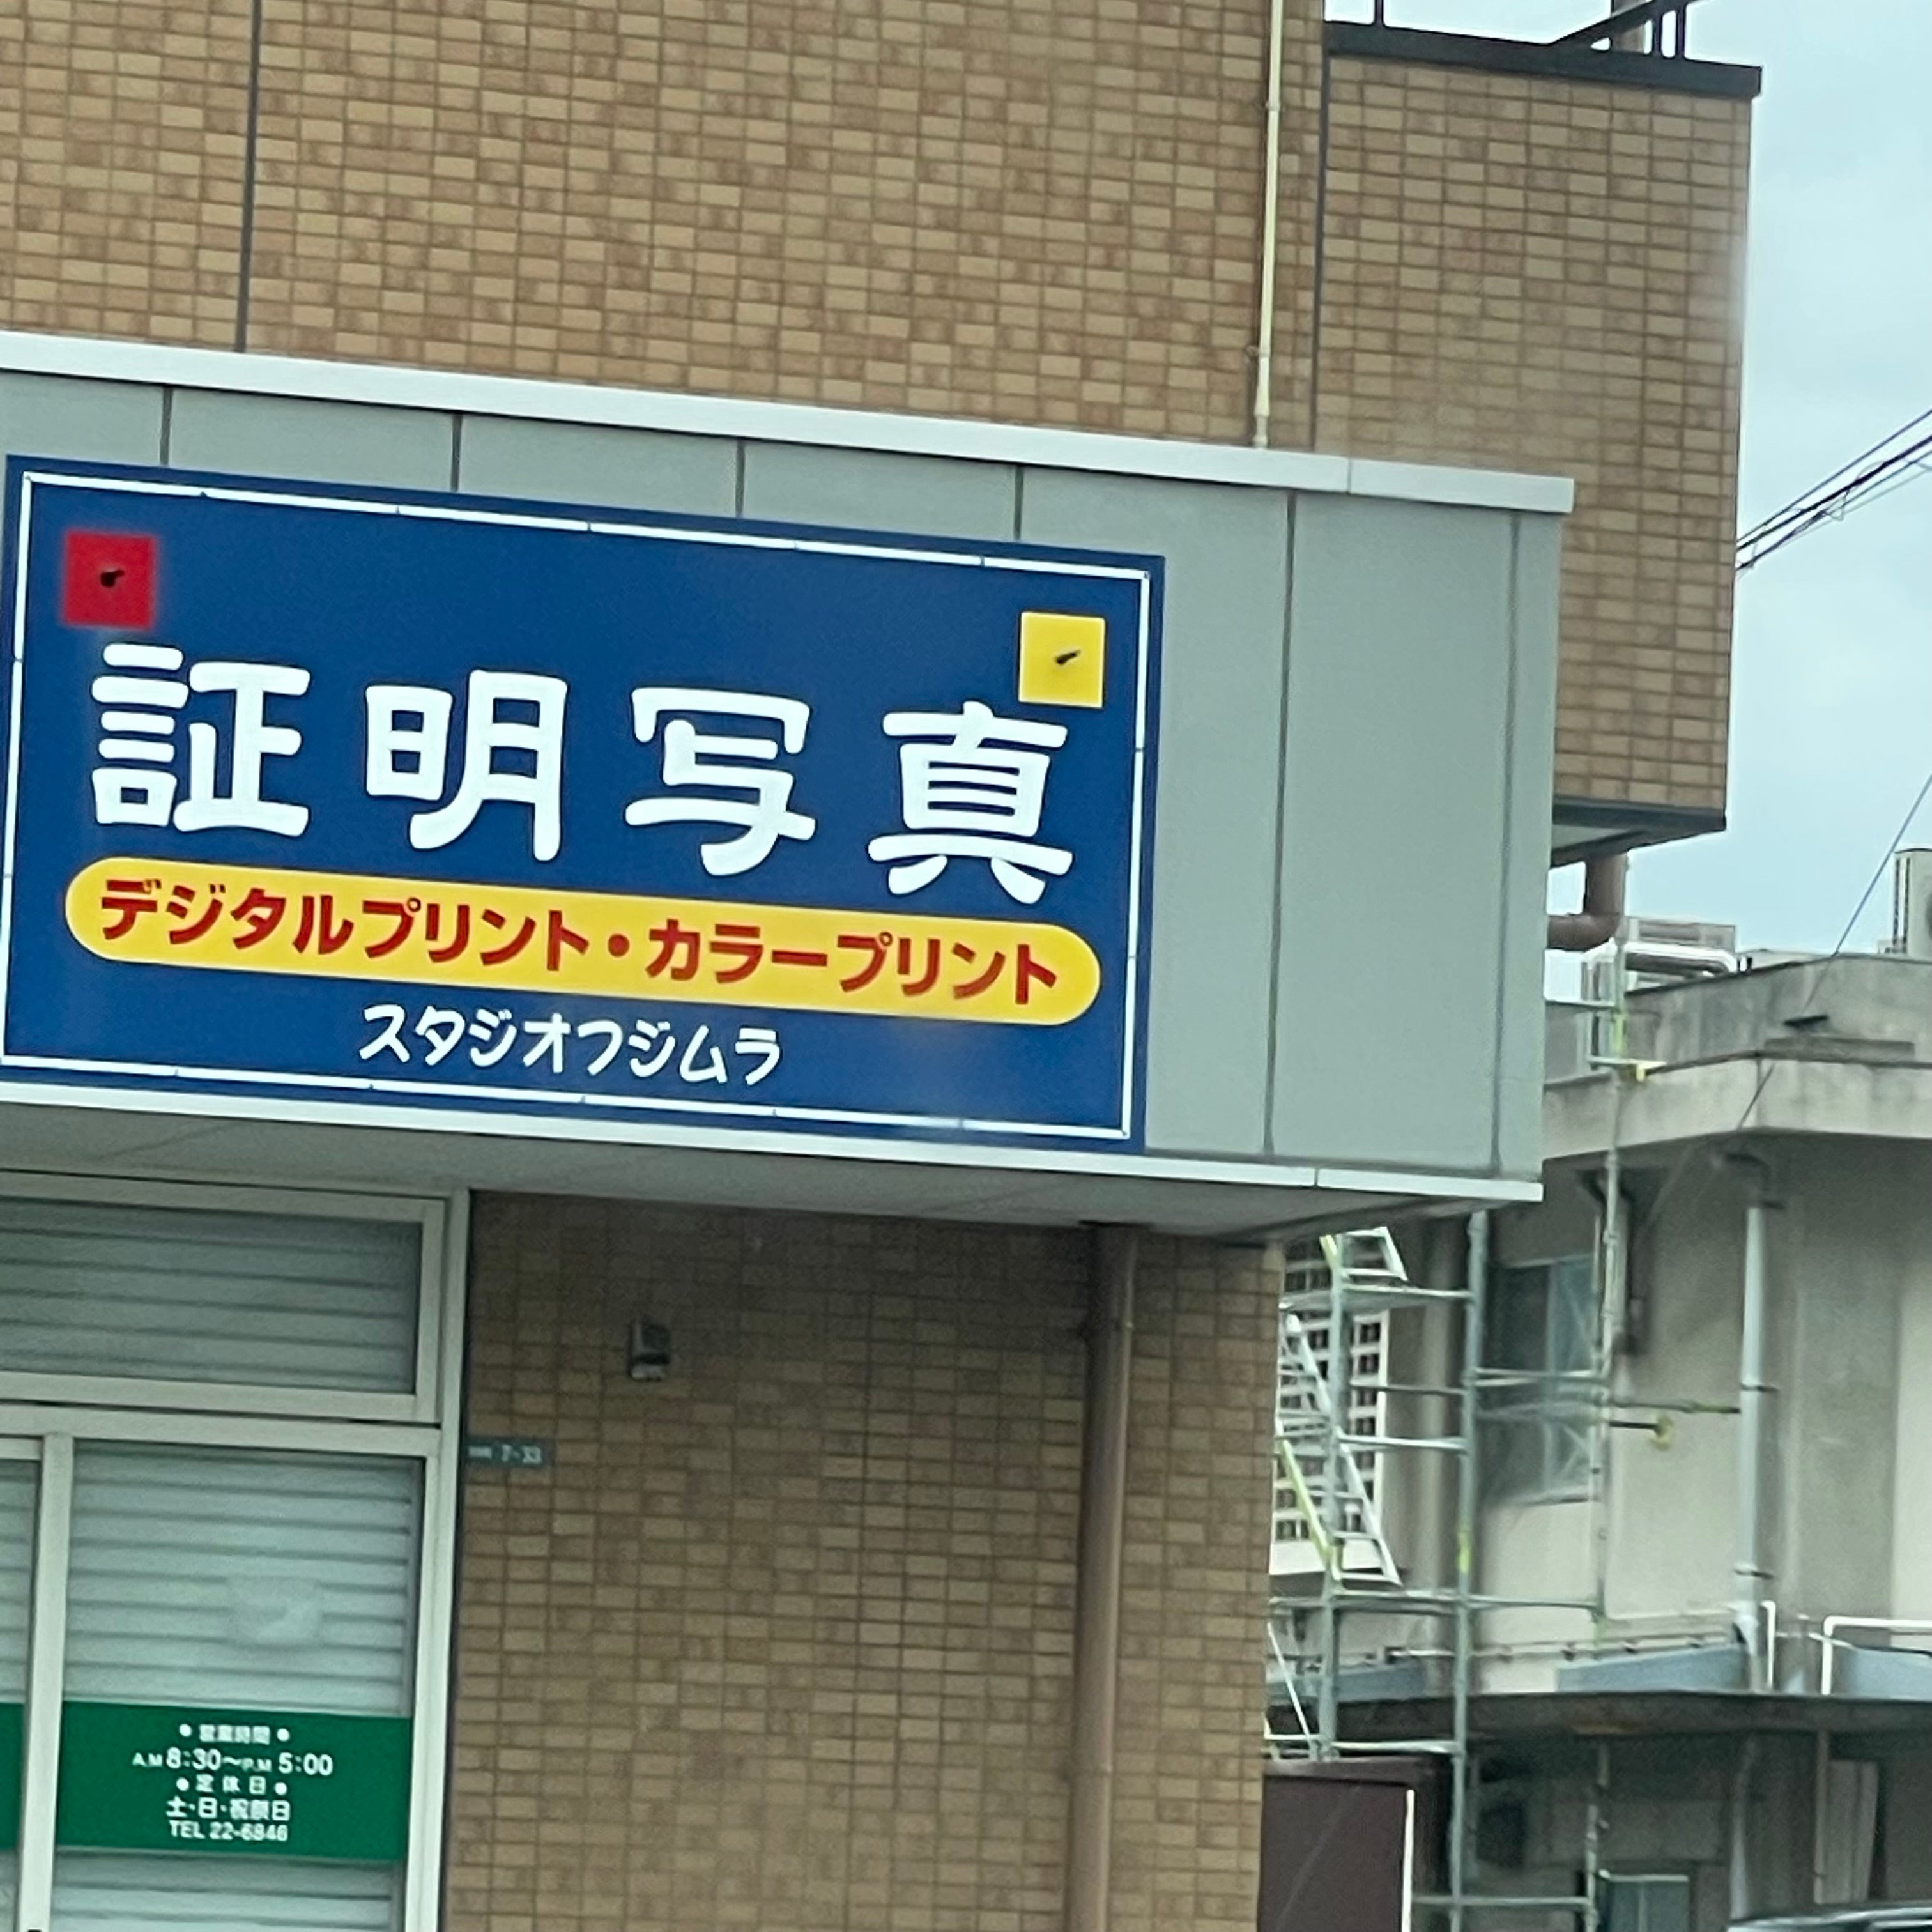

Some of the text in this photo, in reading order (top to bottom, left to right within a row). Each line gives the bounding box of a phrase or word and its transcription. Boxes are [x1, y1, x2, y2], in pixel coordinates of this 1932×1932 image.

[91, 643, 1073, 905] 証明写真
[100, 879, 1057, 1004] デジタルプリント・カラープリント
[359, 1004, 781, 1085] スタジオフジムラ
[278, 1751, 334, 1776] 5:00
[169, 1820, 206, 1839] TEL
